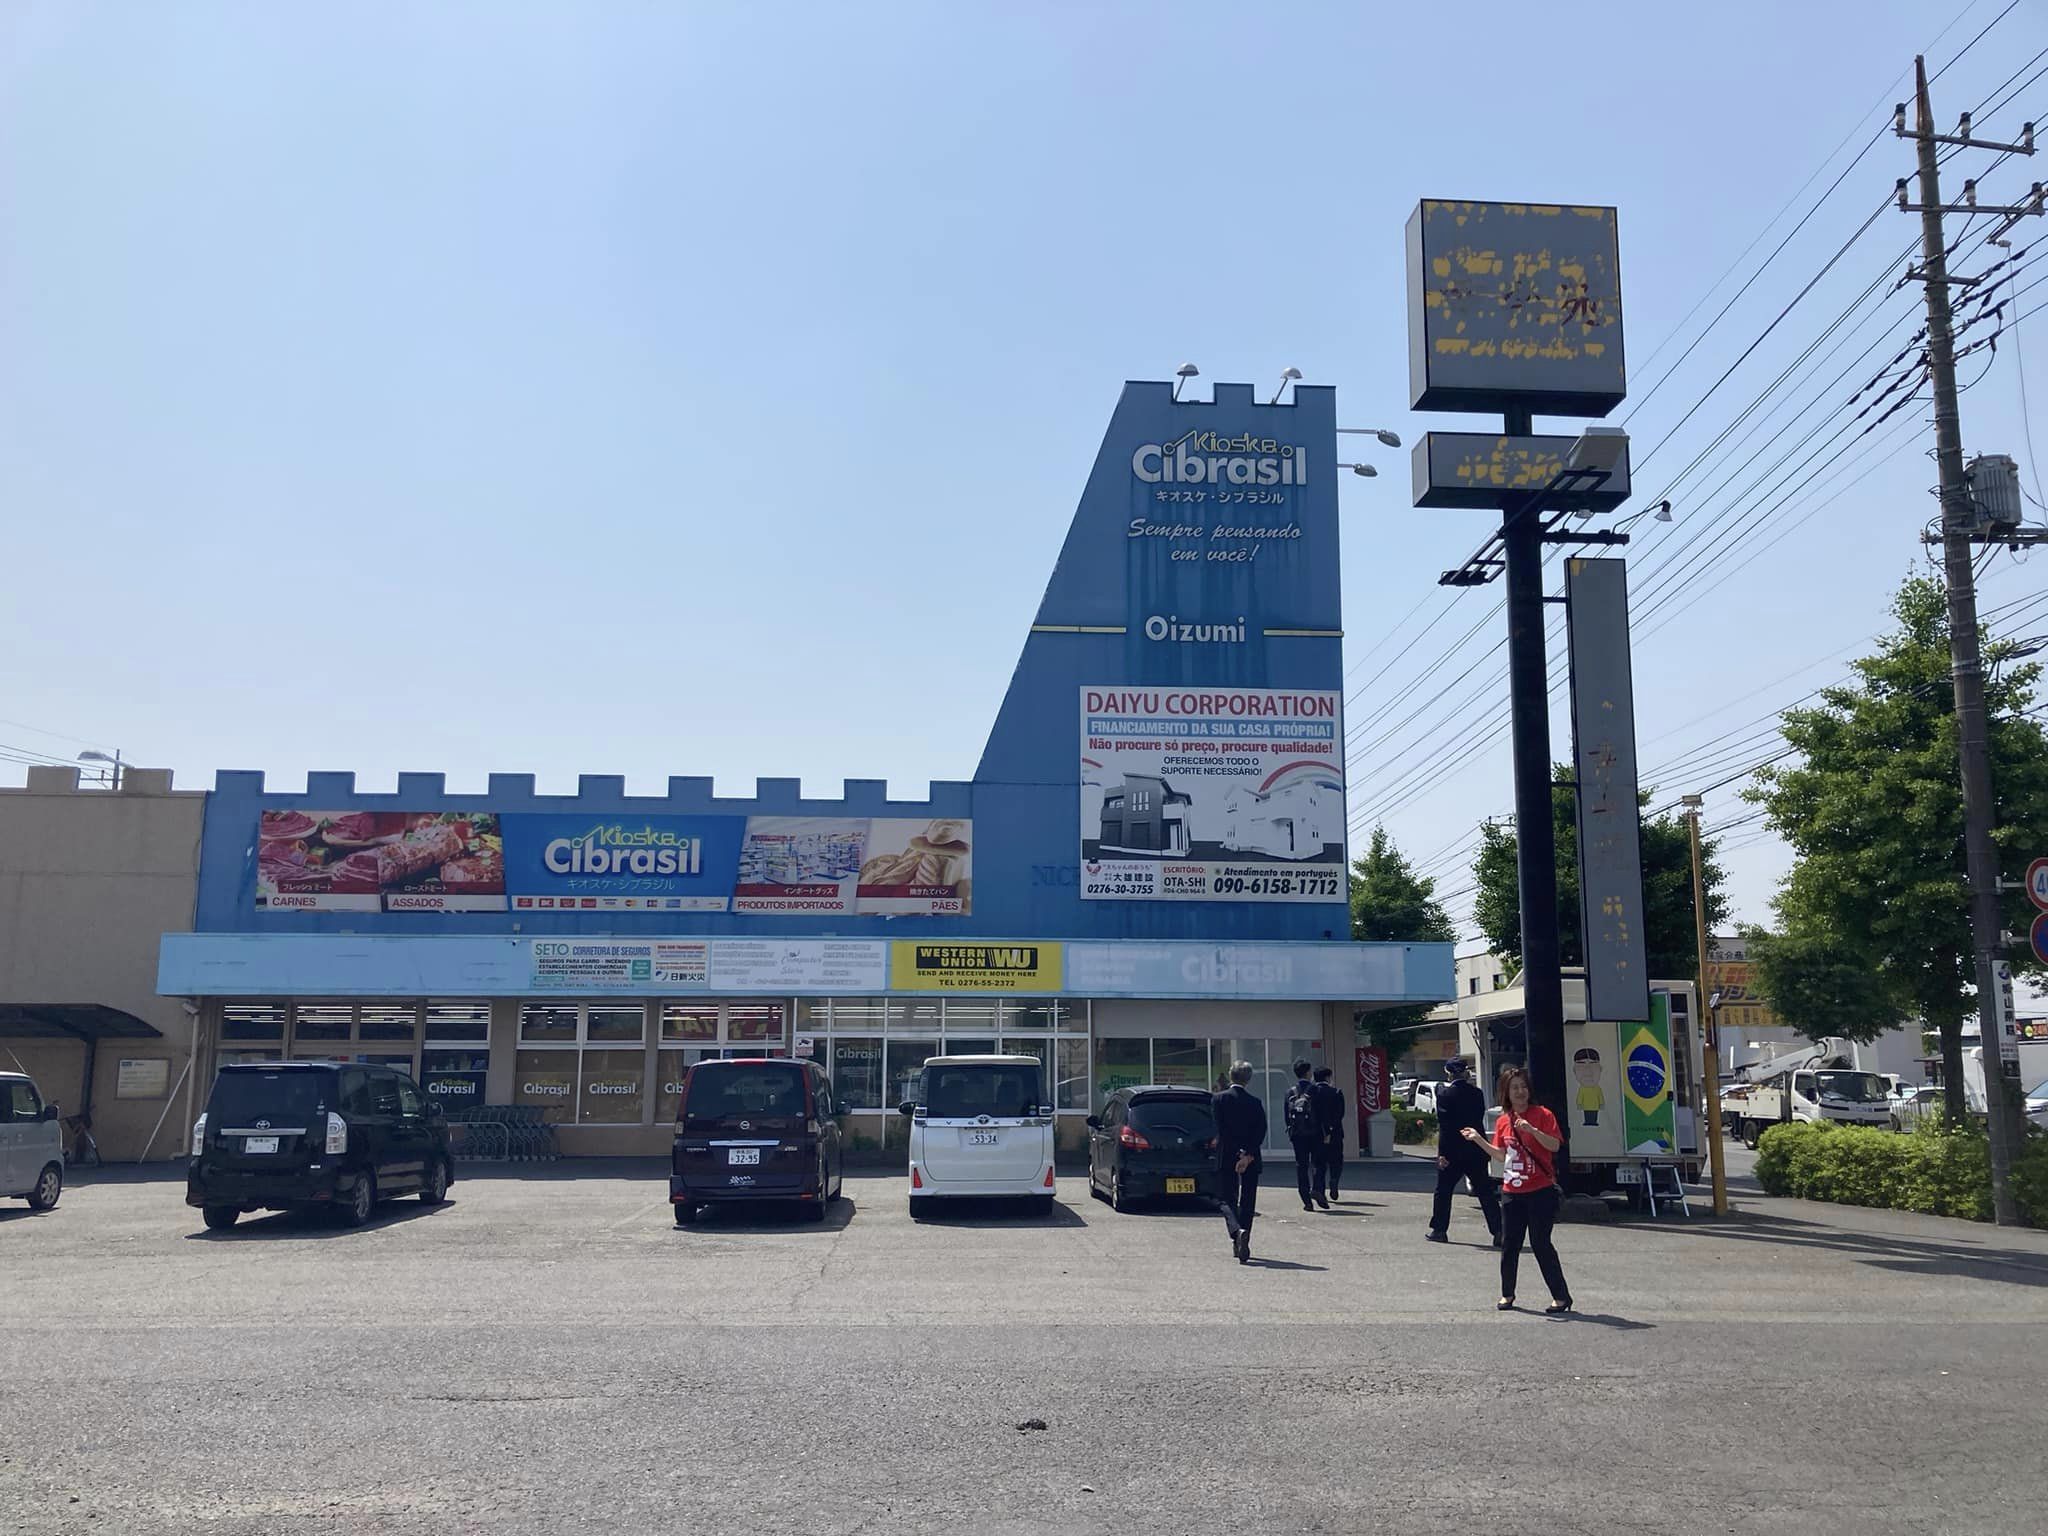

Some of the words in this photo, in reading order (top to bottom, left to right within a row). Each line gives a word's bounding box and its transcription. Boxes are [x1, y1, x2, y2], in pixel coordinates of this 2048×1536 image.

[1132, 444, 1307, 485] Cibrasil
[1127, 518, 1203, 540] Sempre
[1211, 522, 1302, 541] pensando
[1171, 550, 1199, 561] em
[1207, 544, 1260, 562] você!
[1145, 616, 1245, 642] Oizumi
[1087, 692, 1159, 714] DAIYU
[1165, 694, 1334, 717] CORPORATION
[1091, 720, 1188, 734] FINANCIAMENTO
[1192, 722, 1208, 735] DA
[1212, 723, 1235, 735] SUA
[1239, 723, 1271, 736] CASA
[1274, 722, 1330, 737] PRÓPRIA!
[1089, 738, 1112, 749] Não
[1115, 741, 1161, 752] procure
[1165, 739, 1178, 751] só
[1182, 742, 1219, 754] preço,
[1222, 743, 1267, 754] procure
[1271, 742, 1333, 755] qualidade!
[1163, 757, 1224, 765] OFERECEMOS
[1227, 757, 1250, 765] TODO
[1252, 758, 1259, 766] O
[1161, 767, 1202, 775] SUPORTE
[1204, 766, 1262, 776] NECESSÁRIO!
[545, 838, 701, 873] Cibrasil
[1163, 865, 1206, 874] ESCRITÓRIO:
[1224, 867, 1278, 876] Atendimento
[1280, 869, 1293, 877] em
[1295, 868, 1338, 879] português
[1163, 877, 1206, 887] OTA-SHI
[1213, 877, 1338, 895] 090-6158-1712
[2036, 874, 2048, 895] 4
[1087, 884, 1154, 895] 0276-30-3755
[272, 896, 317, 907] CARNES
[392, 898, 444, 908] ASSADOS
[737, 901, 785, 910] PRODUTOS
[786, 901, 844, 911] IMPORTADOS
[535, 943, 569, 956] SETO
[573, 945, 611, 956] CORRETORA
[621, 946, 651, 957] SEGUROS
[921, 948, 986, 958] WESTERN
[941, 958, 986, 968] UNION
[994, 949, 1031, 968] WU
[958, 979, 1015, 987] 0276-55-2372
[836, 1047, 881, 1060] Cibrasil
[428, 1081, 476, 1095] Cibrasil
[524, 1082, 570, 1095] Cibrasil
[589, 1082, 636, 1095] Cibrasil
[736, 1154, 758, 1163] 32-95
